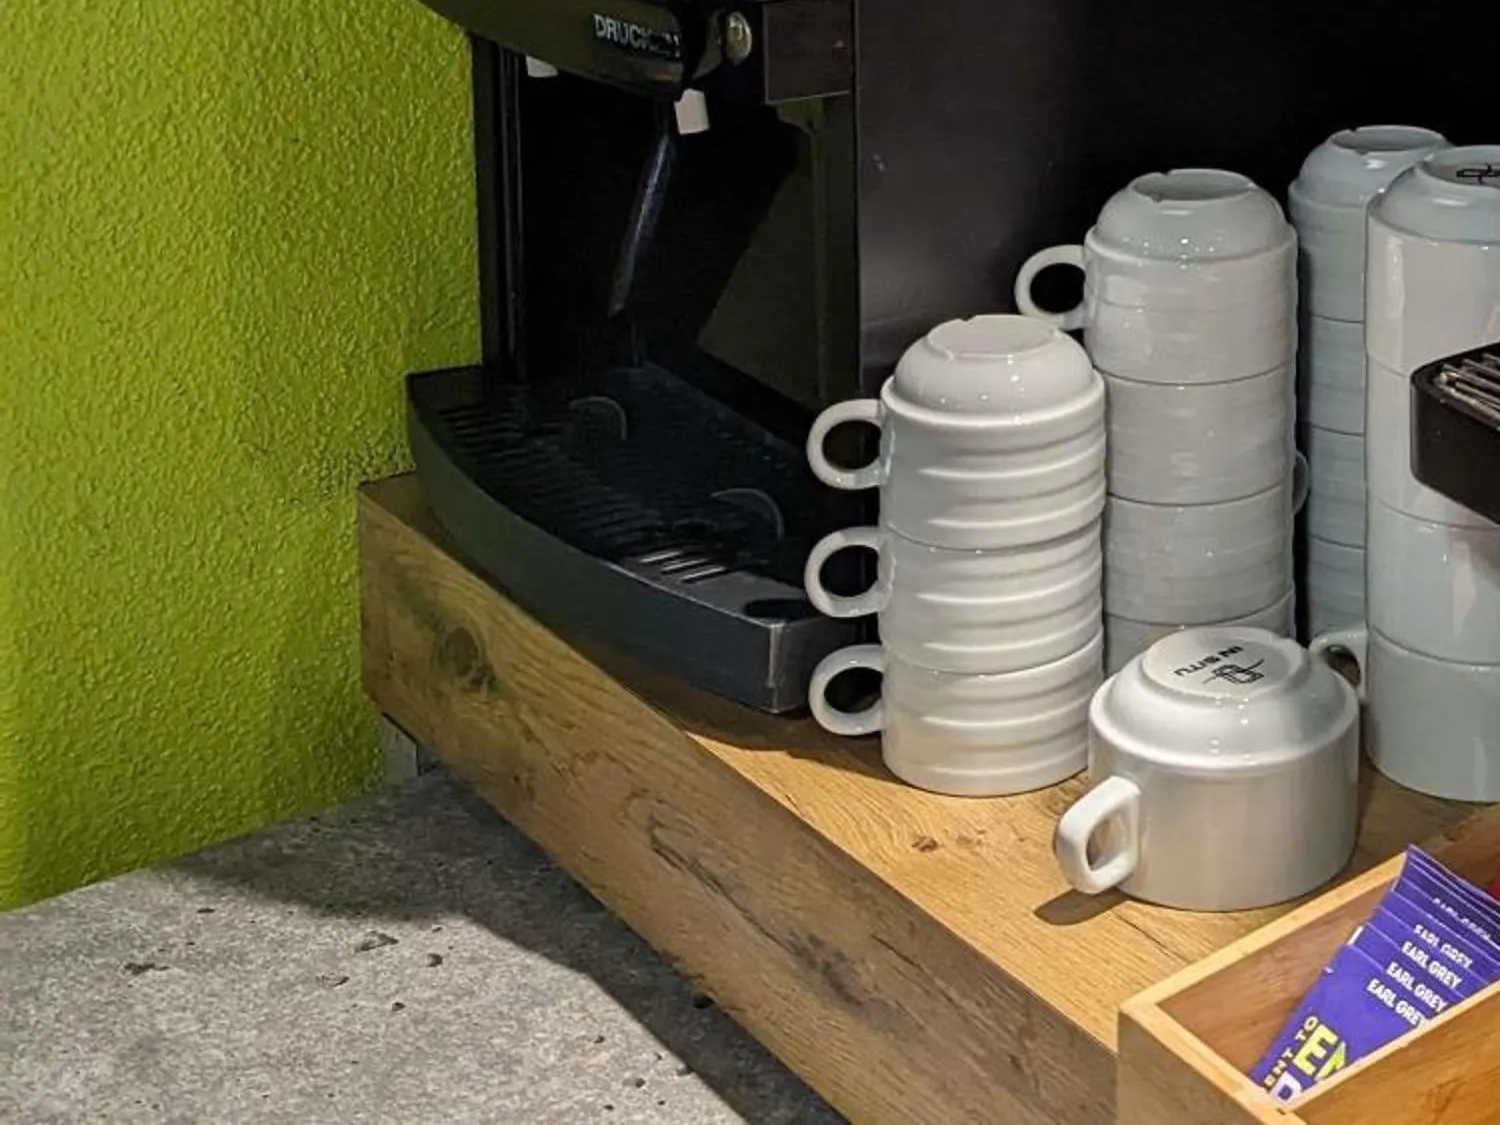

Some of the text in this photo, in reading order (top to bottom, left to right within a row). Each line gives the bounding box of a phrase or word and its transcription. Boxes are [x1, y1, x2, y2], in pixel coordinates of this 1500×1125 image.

[1386, 960, 1449, 1014] EARL GREY
[1401, 940, 1464, 991] EARL GREY
[1366, 977, 1398, 1010] EARL
